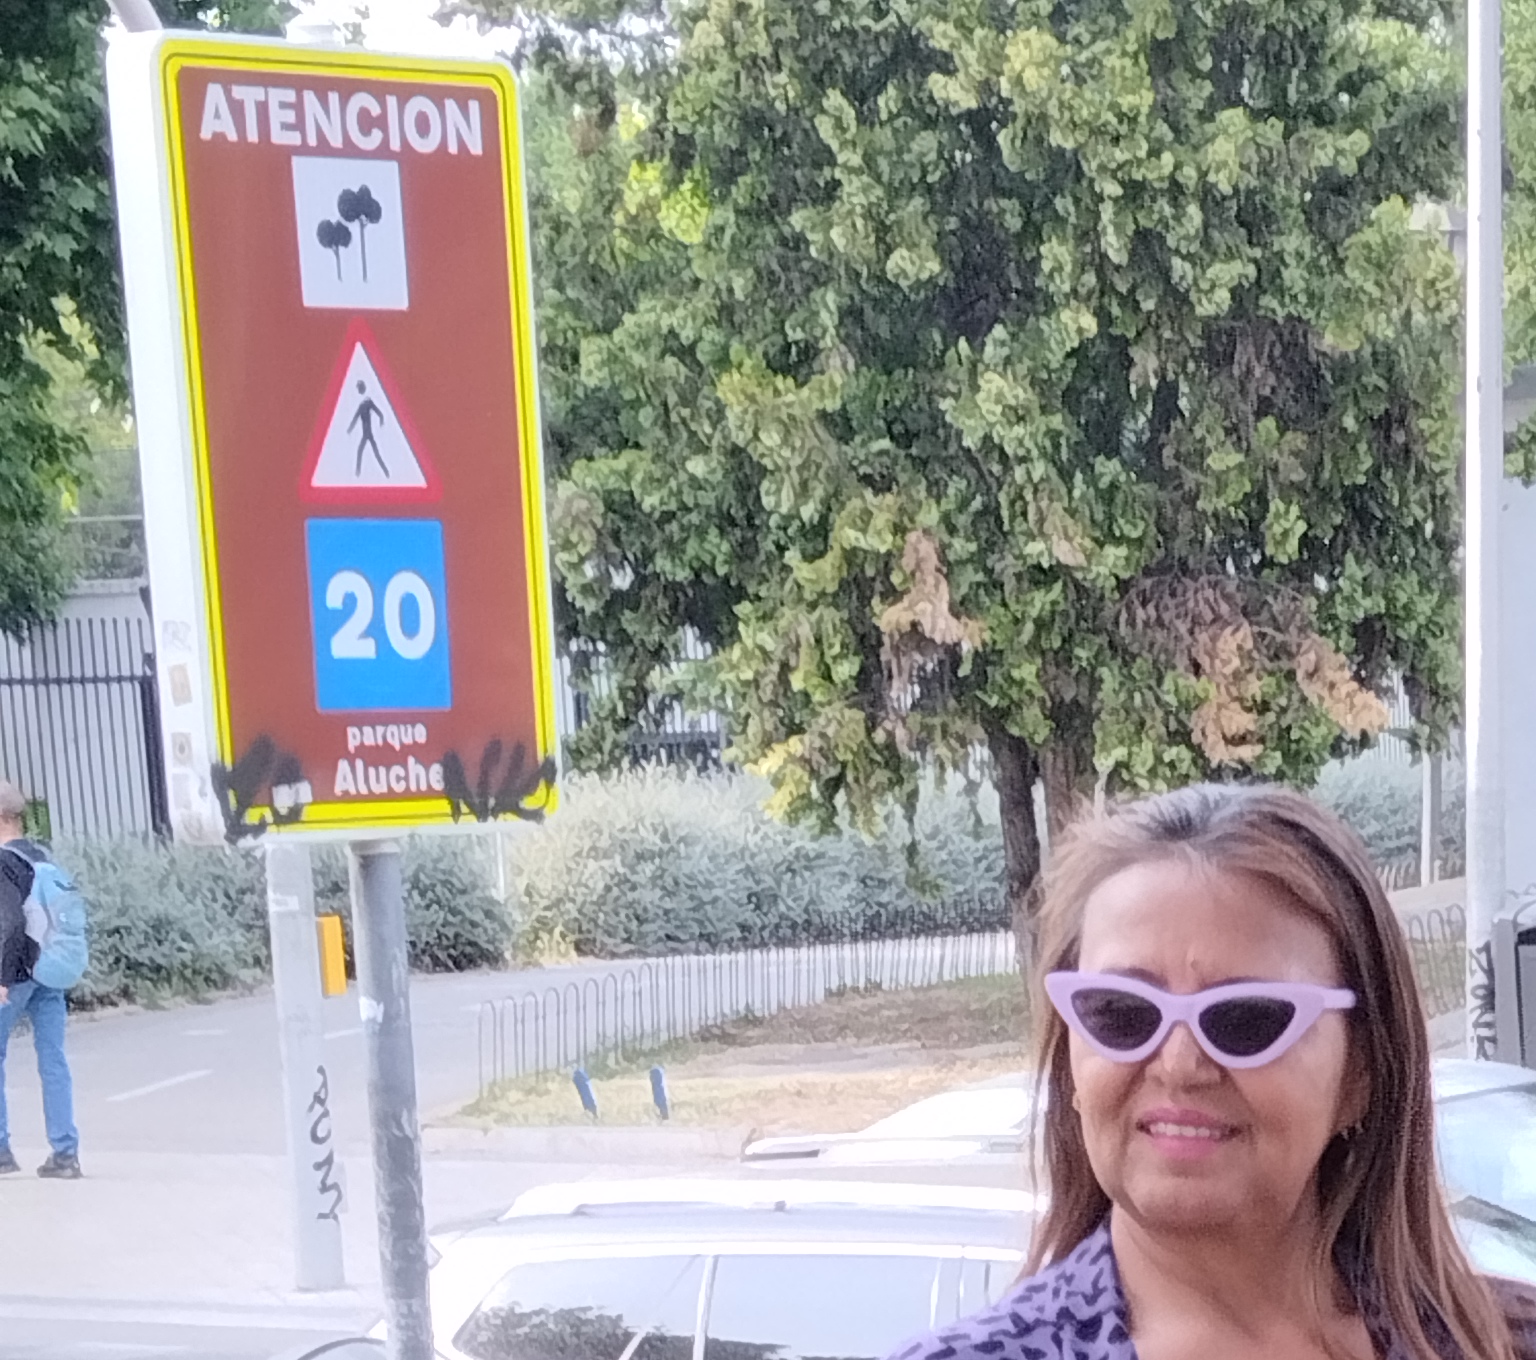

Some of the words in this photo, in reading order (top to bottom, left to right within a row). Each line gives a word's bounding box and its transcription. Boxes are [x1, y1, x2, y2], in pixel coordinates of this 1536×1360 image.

[199, 82, 483, 156] ATENCION
[326, 569, 435, 660] 20
[346, 722, 428, 754] parque
[334, 756, 444, 796] Aluche
